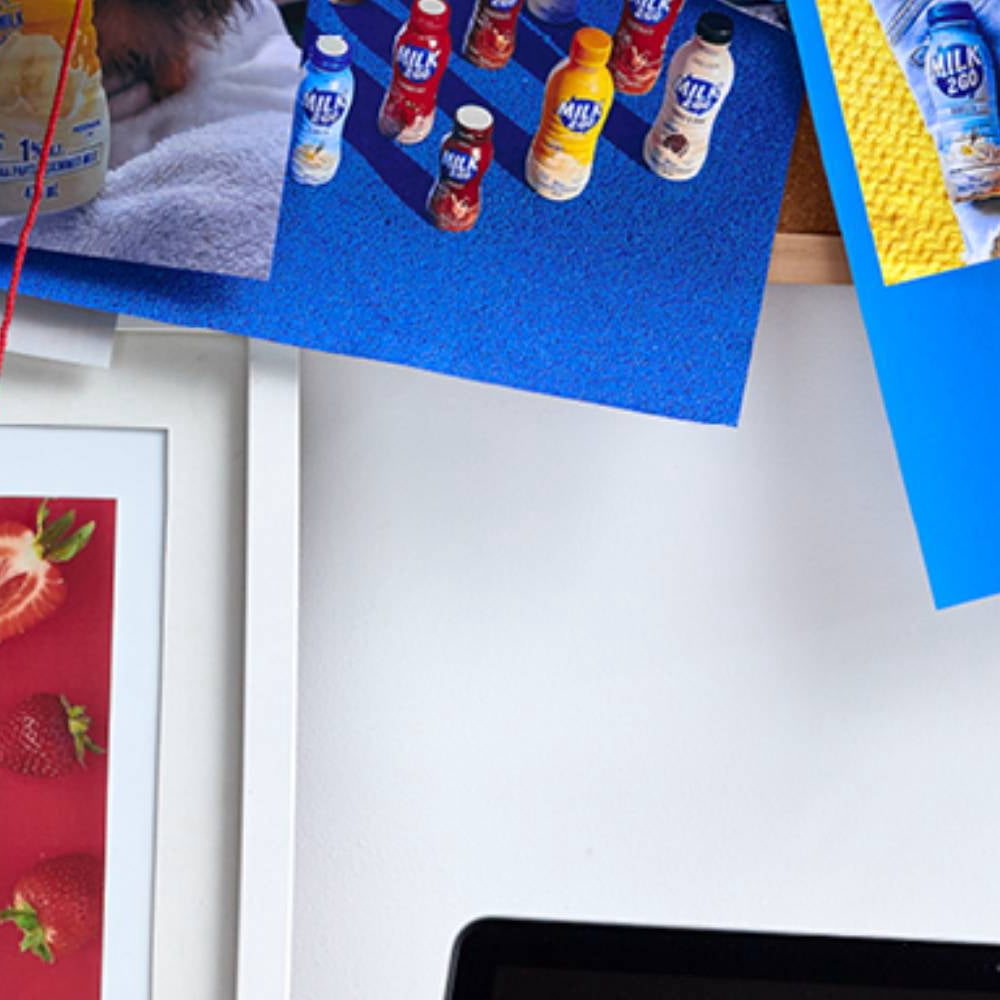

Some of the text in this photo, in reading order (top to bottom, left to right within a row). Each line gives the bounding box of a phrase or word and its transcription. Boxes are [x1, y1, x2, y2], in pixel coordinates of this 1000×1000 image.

[399, 45, 440, 68] MILK
[931, 45, 982, 79] MILK
[674, 80, 721, 103] MILK
[947, 69, 979, 93] 2GO
[304, 89, 347, 112] MILK
[556, 100, 603, 117] MILK
[441, 149, 479, 171] MILK
